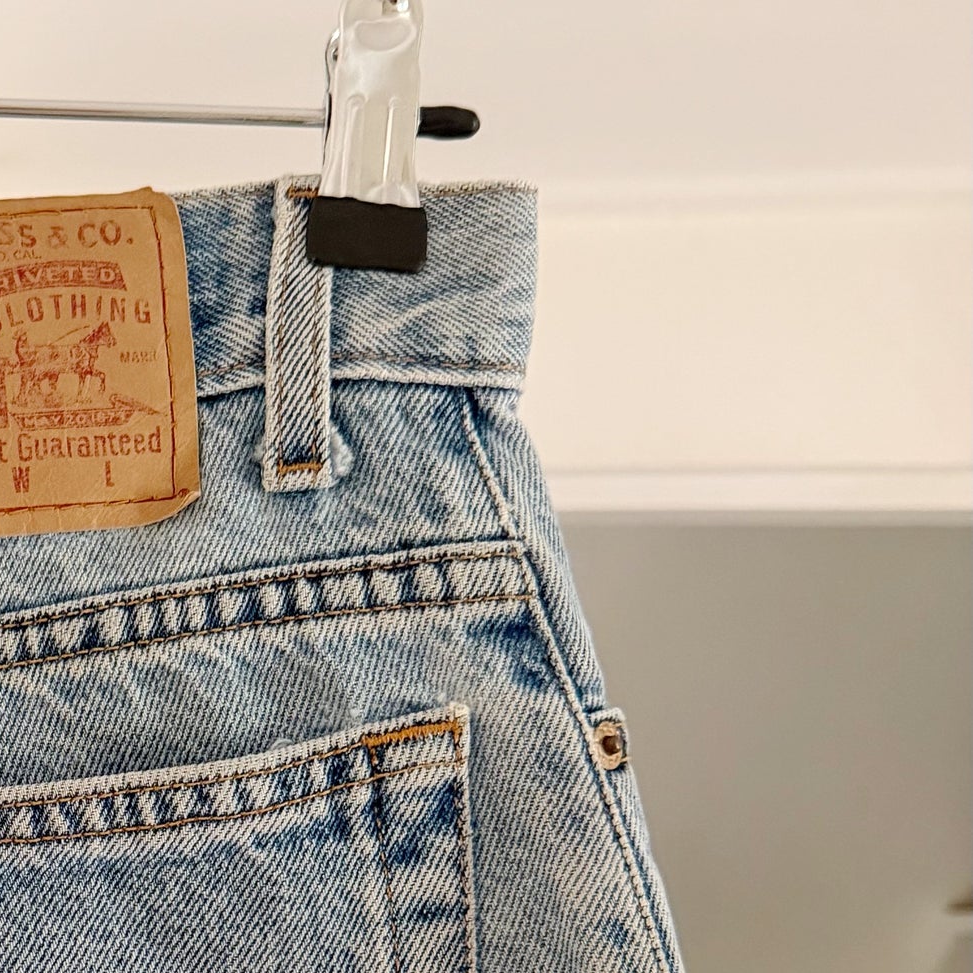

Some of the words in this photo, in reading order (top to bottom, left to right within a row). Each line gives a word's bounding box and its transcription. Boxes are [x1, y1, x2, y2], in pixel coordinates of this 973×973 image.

[47, 225, 68, 249] &
[78, 220, 134, 248] CO.
[17, 426, 162, 462] Guaranteed
[11, 465, 30, 494] W
[104, 460, 115, 488] L
